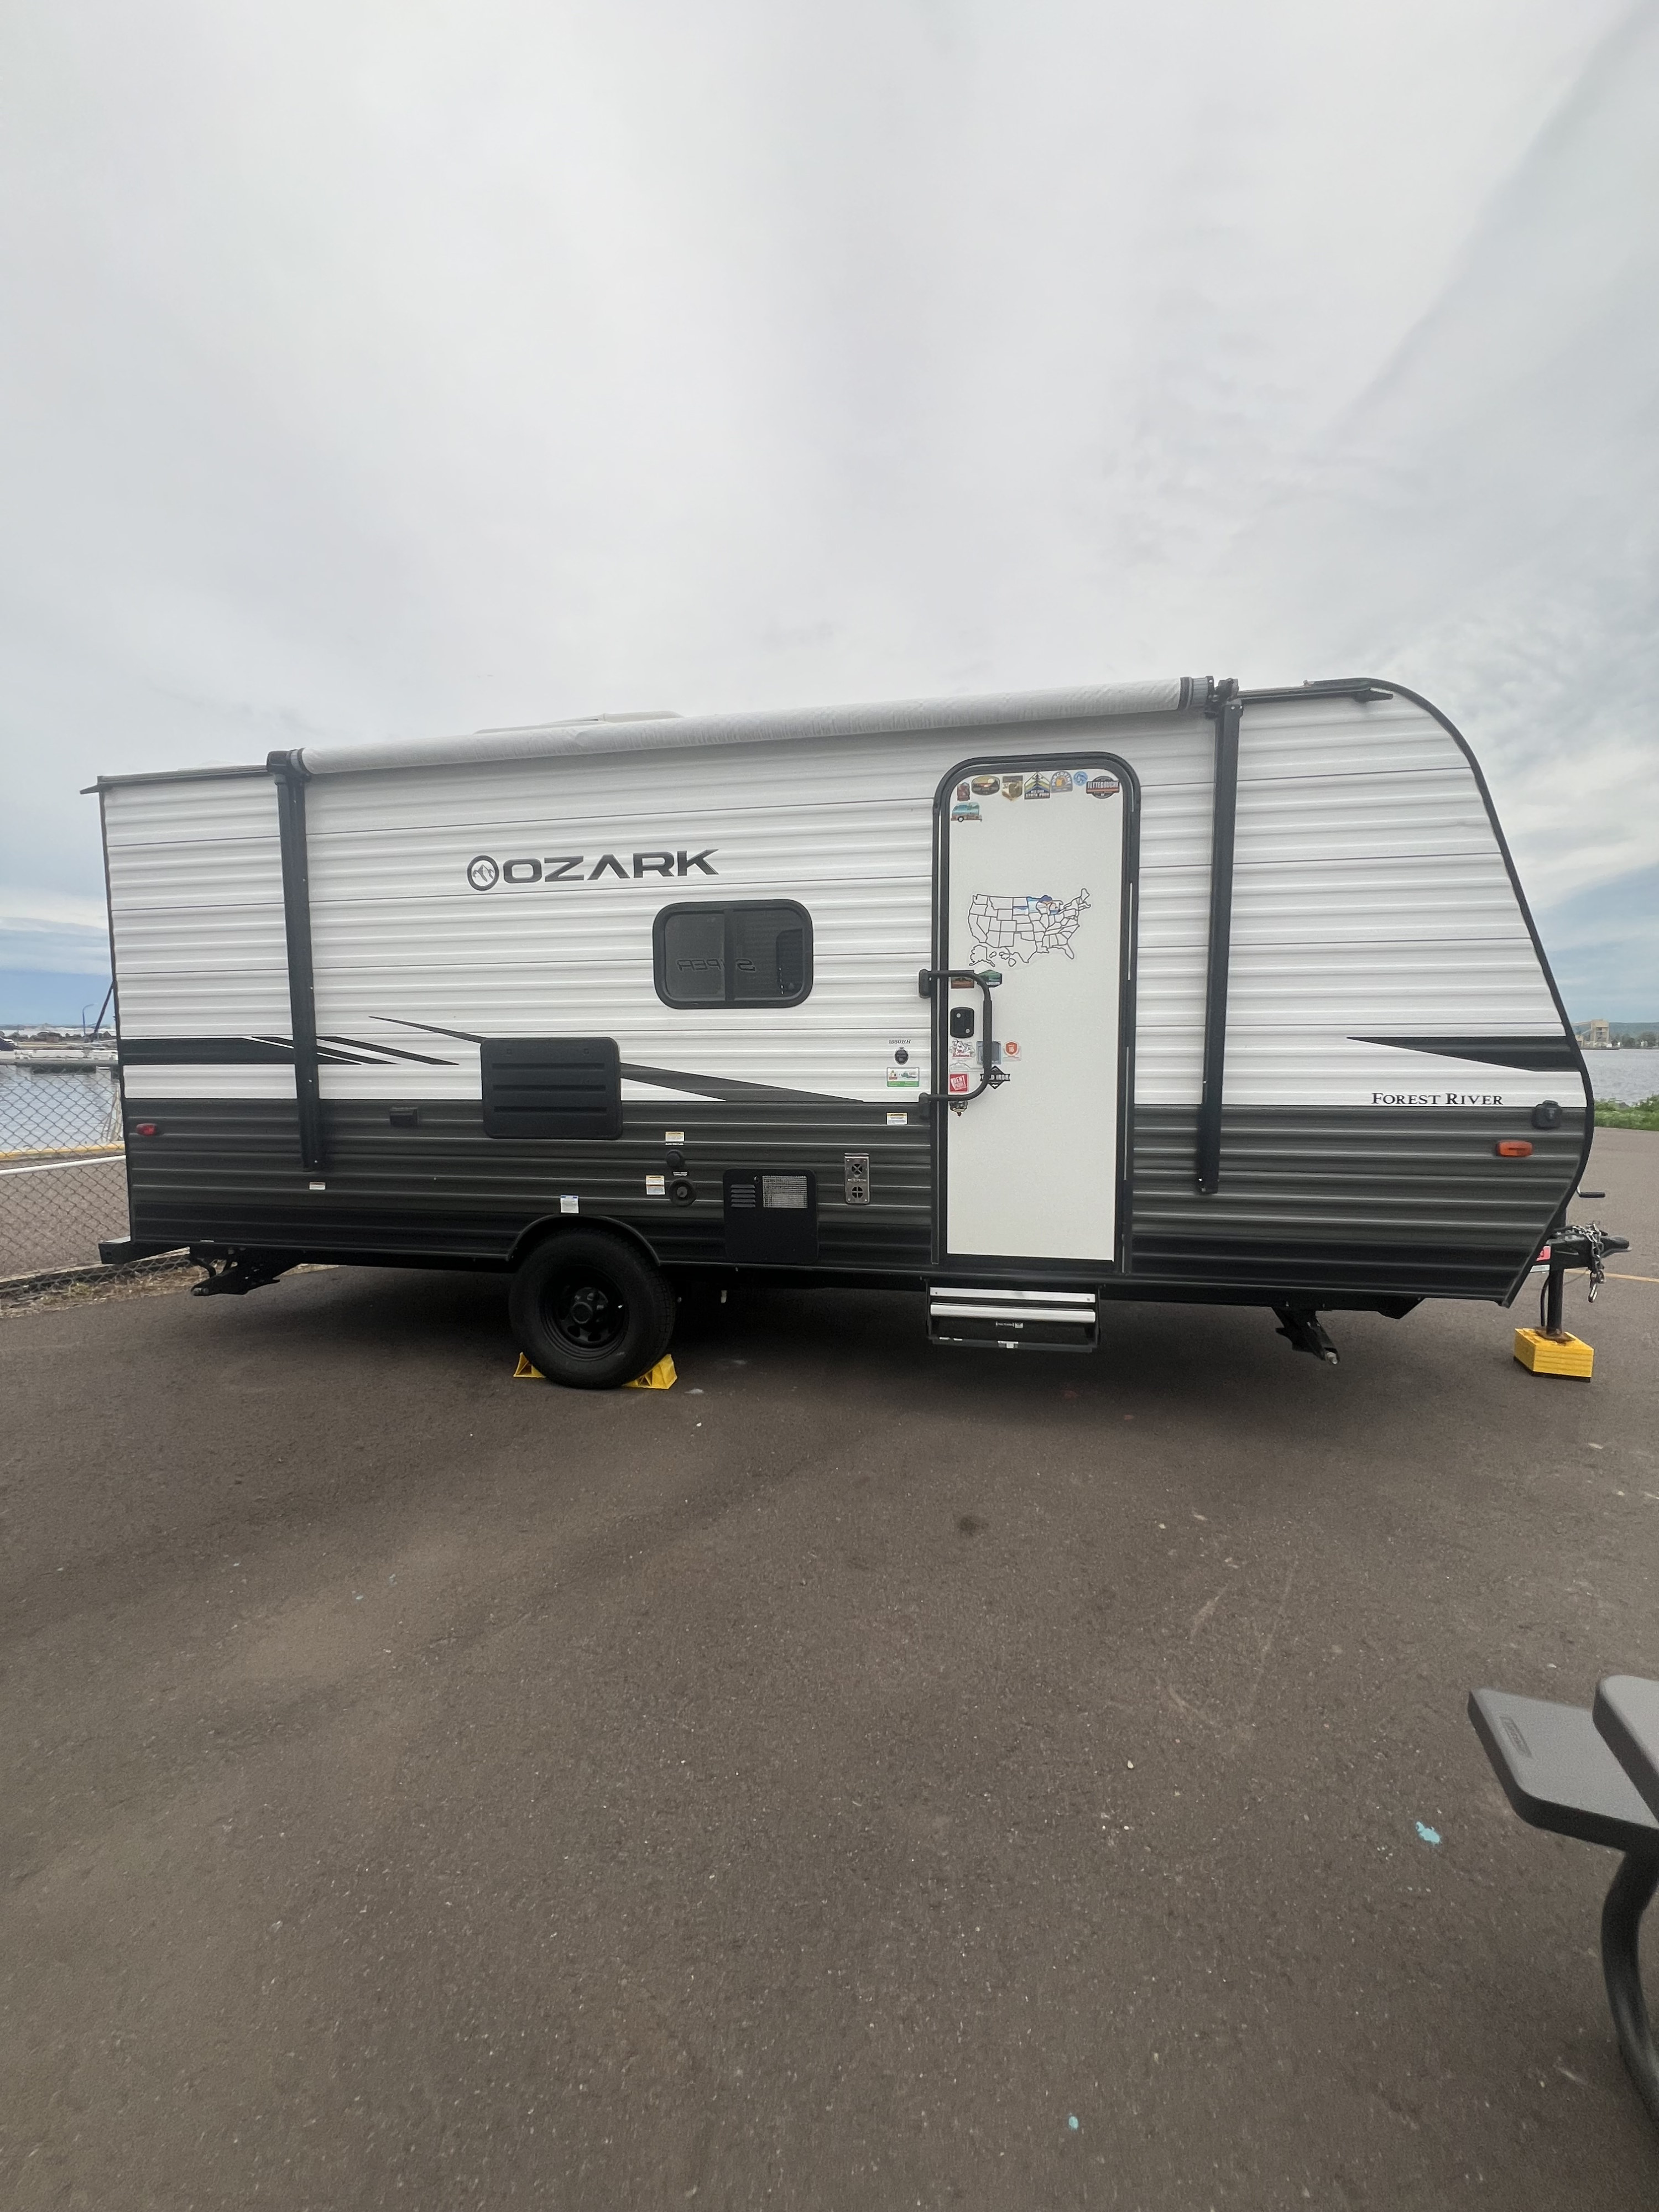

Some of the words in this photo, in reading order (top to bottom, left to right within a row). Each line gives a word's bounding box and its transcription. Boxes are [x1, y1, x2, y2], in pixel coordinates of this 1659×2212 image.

[503, 848, 719, 884] OZARK
[1371, 1092, 1441, 1104] FOREST
[1445, 1093, 1504, 1105] RIVER
